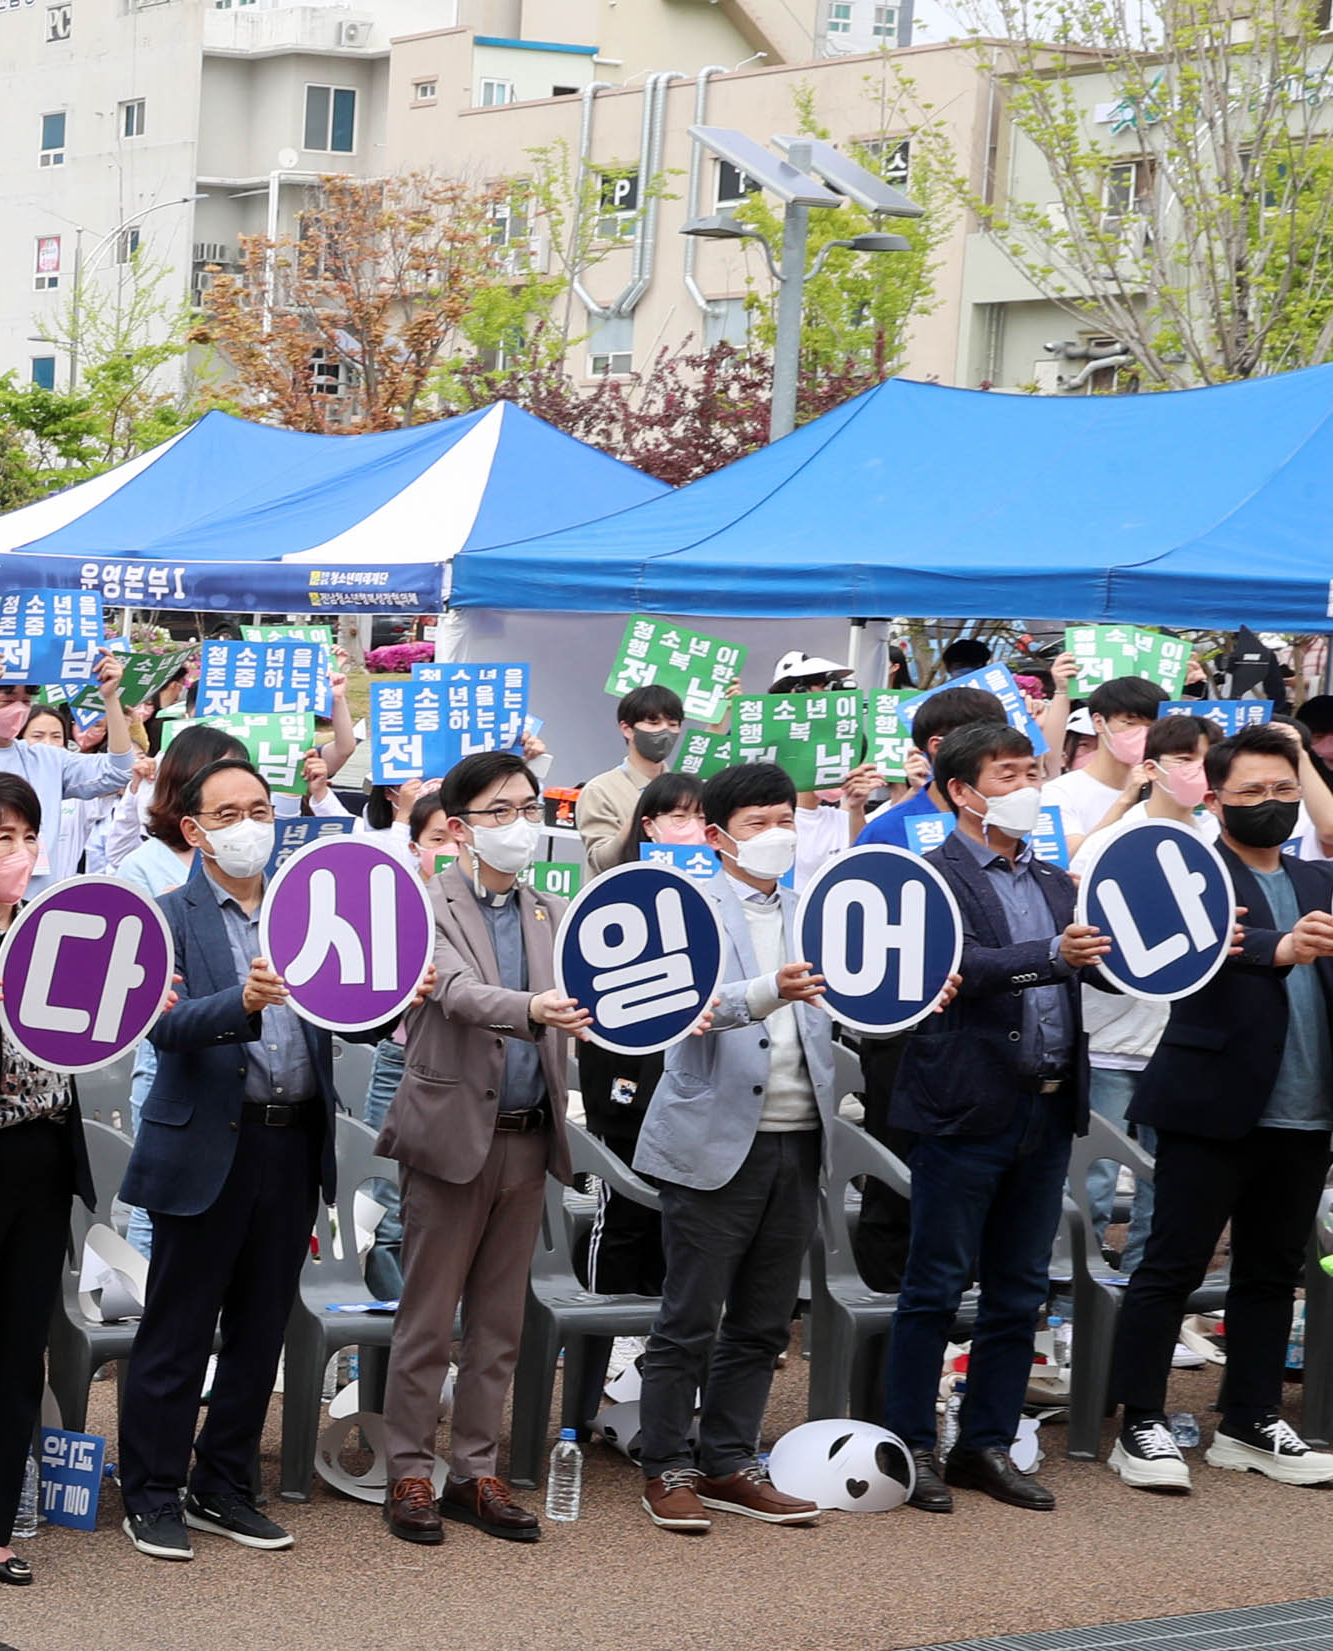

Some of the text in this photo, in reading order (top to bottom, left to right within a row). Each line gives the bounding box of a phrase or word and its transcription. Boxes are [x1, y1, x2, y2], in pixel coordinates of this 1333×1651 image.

[2, 592, 98, 618] 청소년을
[207, 645, 313, 669] 청소년을
[626, 638, 736, 685] 행복한
[631, 619, 741, 666] 청소년이
[1072, 628, 1185, 660] 청소년이
[205, 667, 312, 688] 존중하는
[616, 657, 726, 720] 전남
[377, 686, 495, 712] 청소년을
[738, 696, 858, 722] 청소년이
[377, 706, 496, 732] 존중하는
[738, 718, 859, 745] 행복한
[285, 865, 399, 991] 시
[1097, 839, 1206, 979] 나
[578, 887, 699, 1029] 일
[821, 879, 925, 1001] 어
[20, 910, 144, 1042] 다
